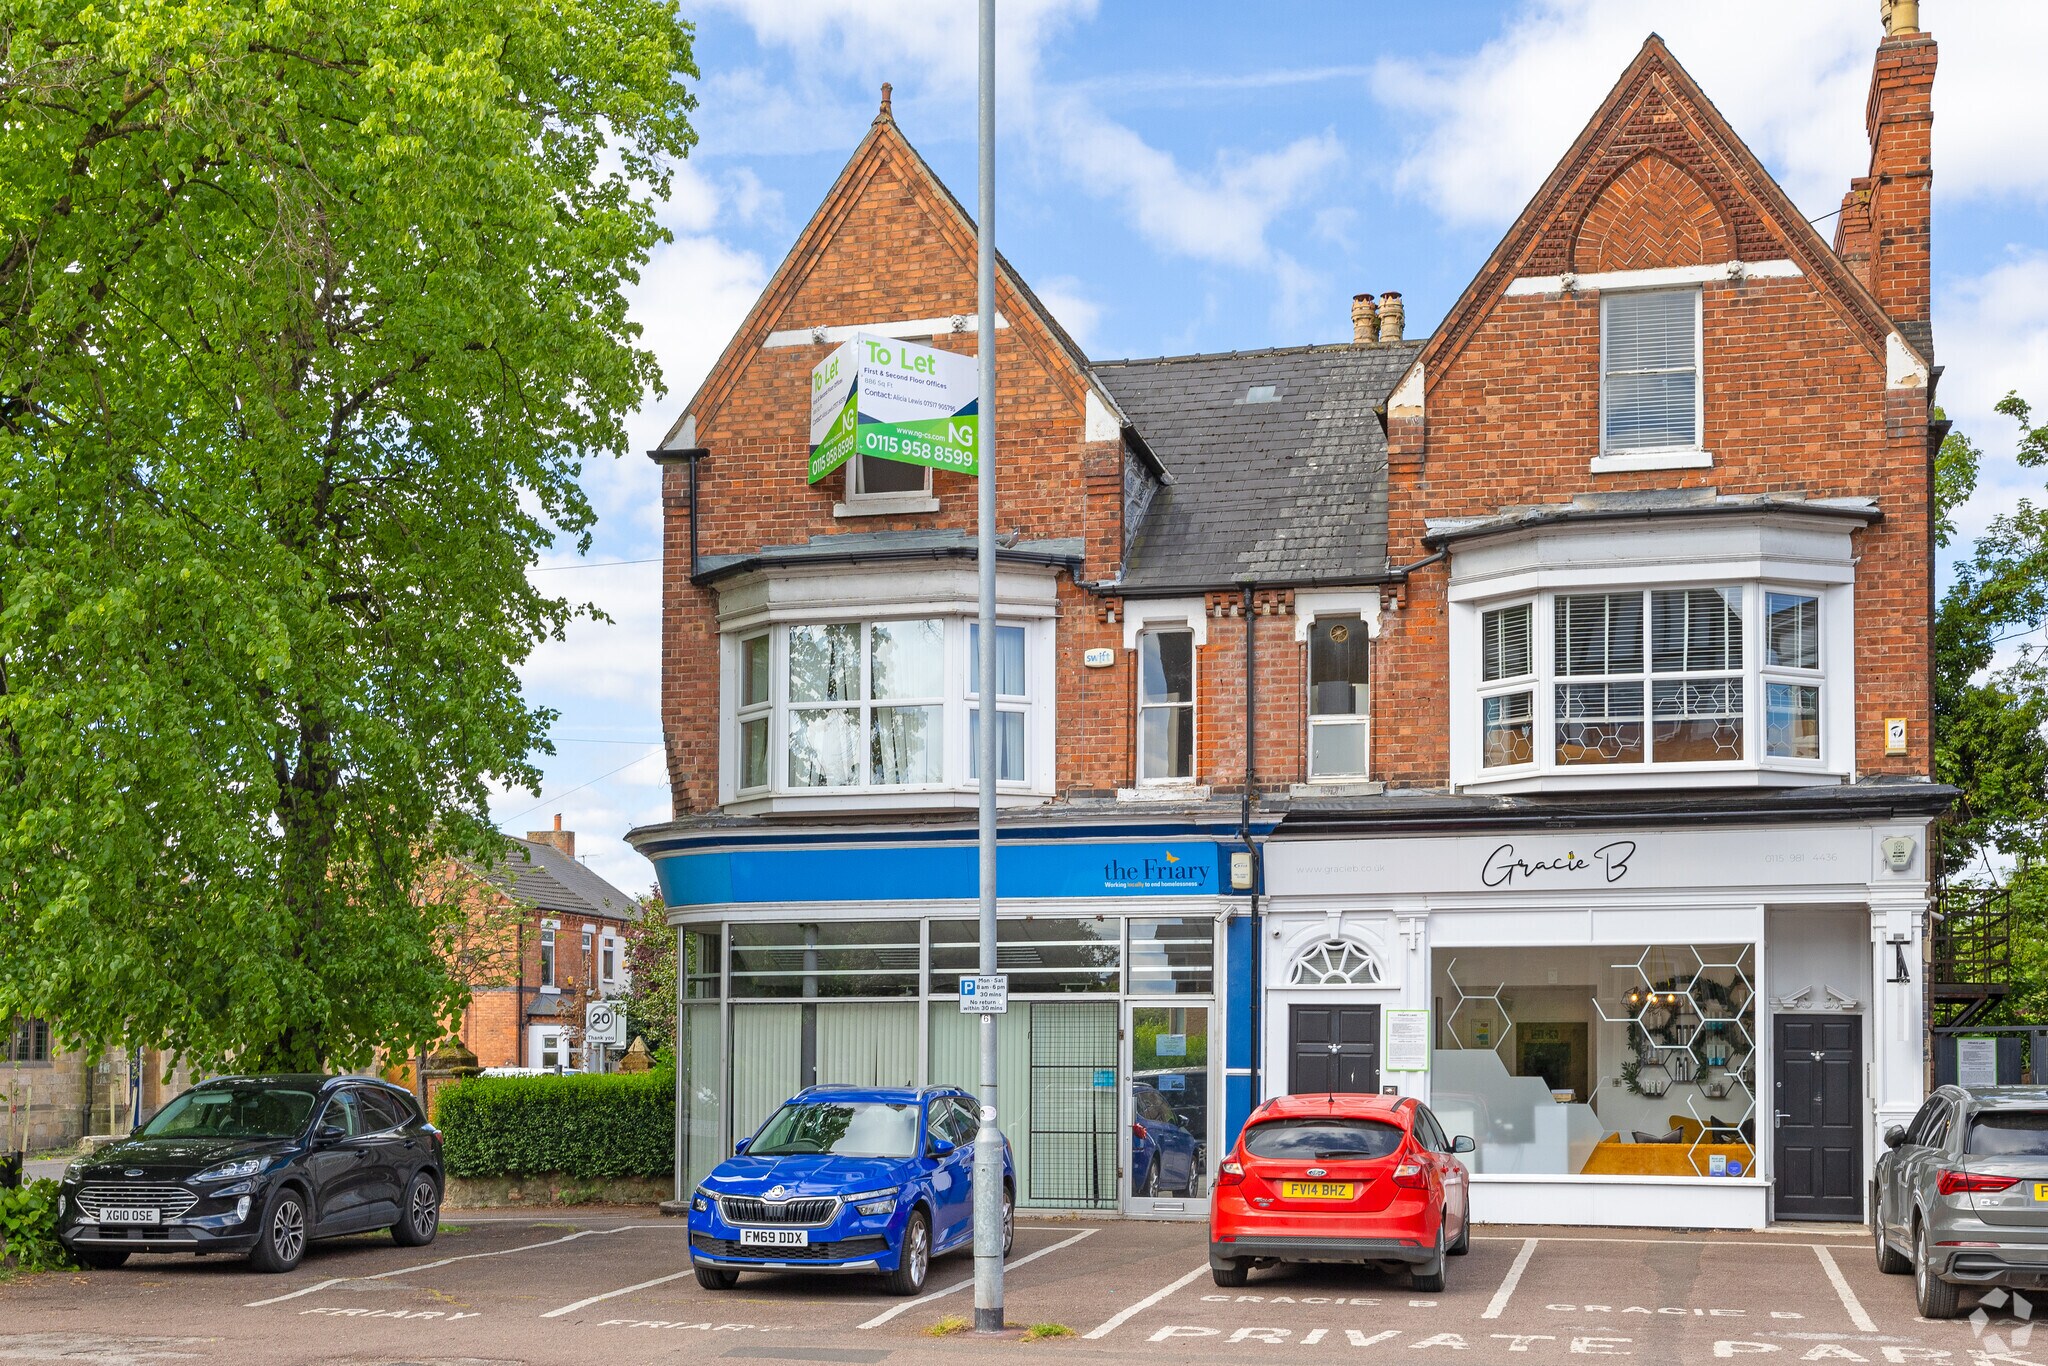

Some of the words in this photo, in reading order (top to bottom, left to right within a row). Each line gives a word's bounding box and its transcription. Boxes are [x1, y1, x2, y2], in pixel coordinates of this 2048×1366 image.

[866, 340, 892, 366] To
[901, 347, 936, 376] Let
[813, 371, 823, 394] To
[825, 356, 839, 384] Let
[864, 367, 878, 376] First
[885, 371, 909, 382] Second
[909, 376, 925, 385] Floor
[925, 379, 948, 390] Offices
[877, 379, 886, 388] Sq
[864, 388, 893, 400] Contact:
[893, 394, 908, 404] Alicia
[908, 396, 923, 407] Lewis
[842, 409, 854, 435] NG
[896, 427, 946, 442] www.ng-cs.com
[948, 422, 974, 447] NG
[812, 455, 826, 476] 0115
[826, 446, 838, 467] 958
[838, 435, 854, 459] 8599
[866, 433, 898, 453] 0115
[901, 440, 932, 457] 958
[933, 445, 974, 468] 8599
[1087, 651, 1111, 663] swift
[1482, 843, 1590, 887] Gracie
[1594, 840, 1637, 883] B
[1765, 854, 1785, 863] 0115
[1812, 853, 1838, 862] 4436
[1104, 859, 1138, 880] the
[1142, 858, 1211, 886] Friary
[1296, 864, 1386, 874] www.gracieb.co.uk
[1104, 881, 1127, 889] Working
[965, 982, 974, 994] P
[592, 1013, 610, 1025] 20
[1291, 1184, 1318, 1195] FV14
[1322, 1184, 1346, 1197] BHZ
[106, 1210, 130, 1221] XG10
[131, 1210, 153, 1221] OSE
[745, 1230, 776, 1243] FM69
[778, 1232, 803, 1244] DDX
[1200, 1295, 1383, 1306] GRACIE
[1408, 1299, 1438, 1308] B
[298, 1307, 483, 1321] FRIARY
[1545, 1303, 1748, 1317] GRACIE
[1145, 1325, 1634, 1356] PRIVATE
